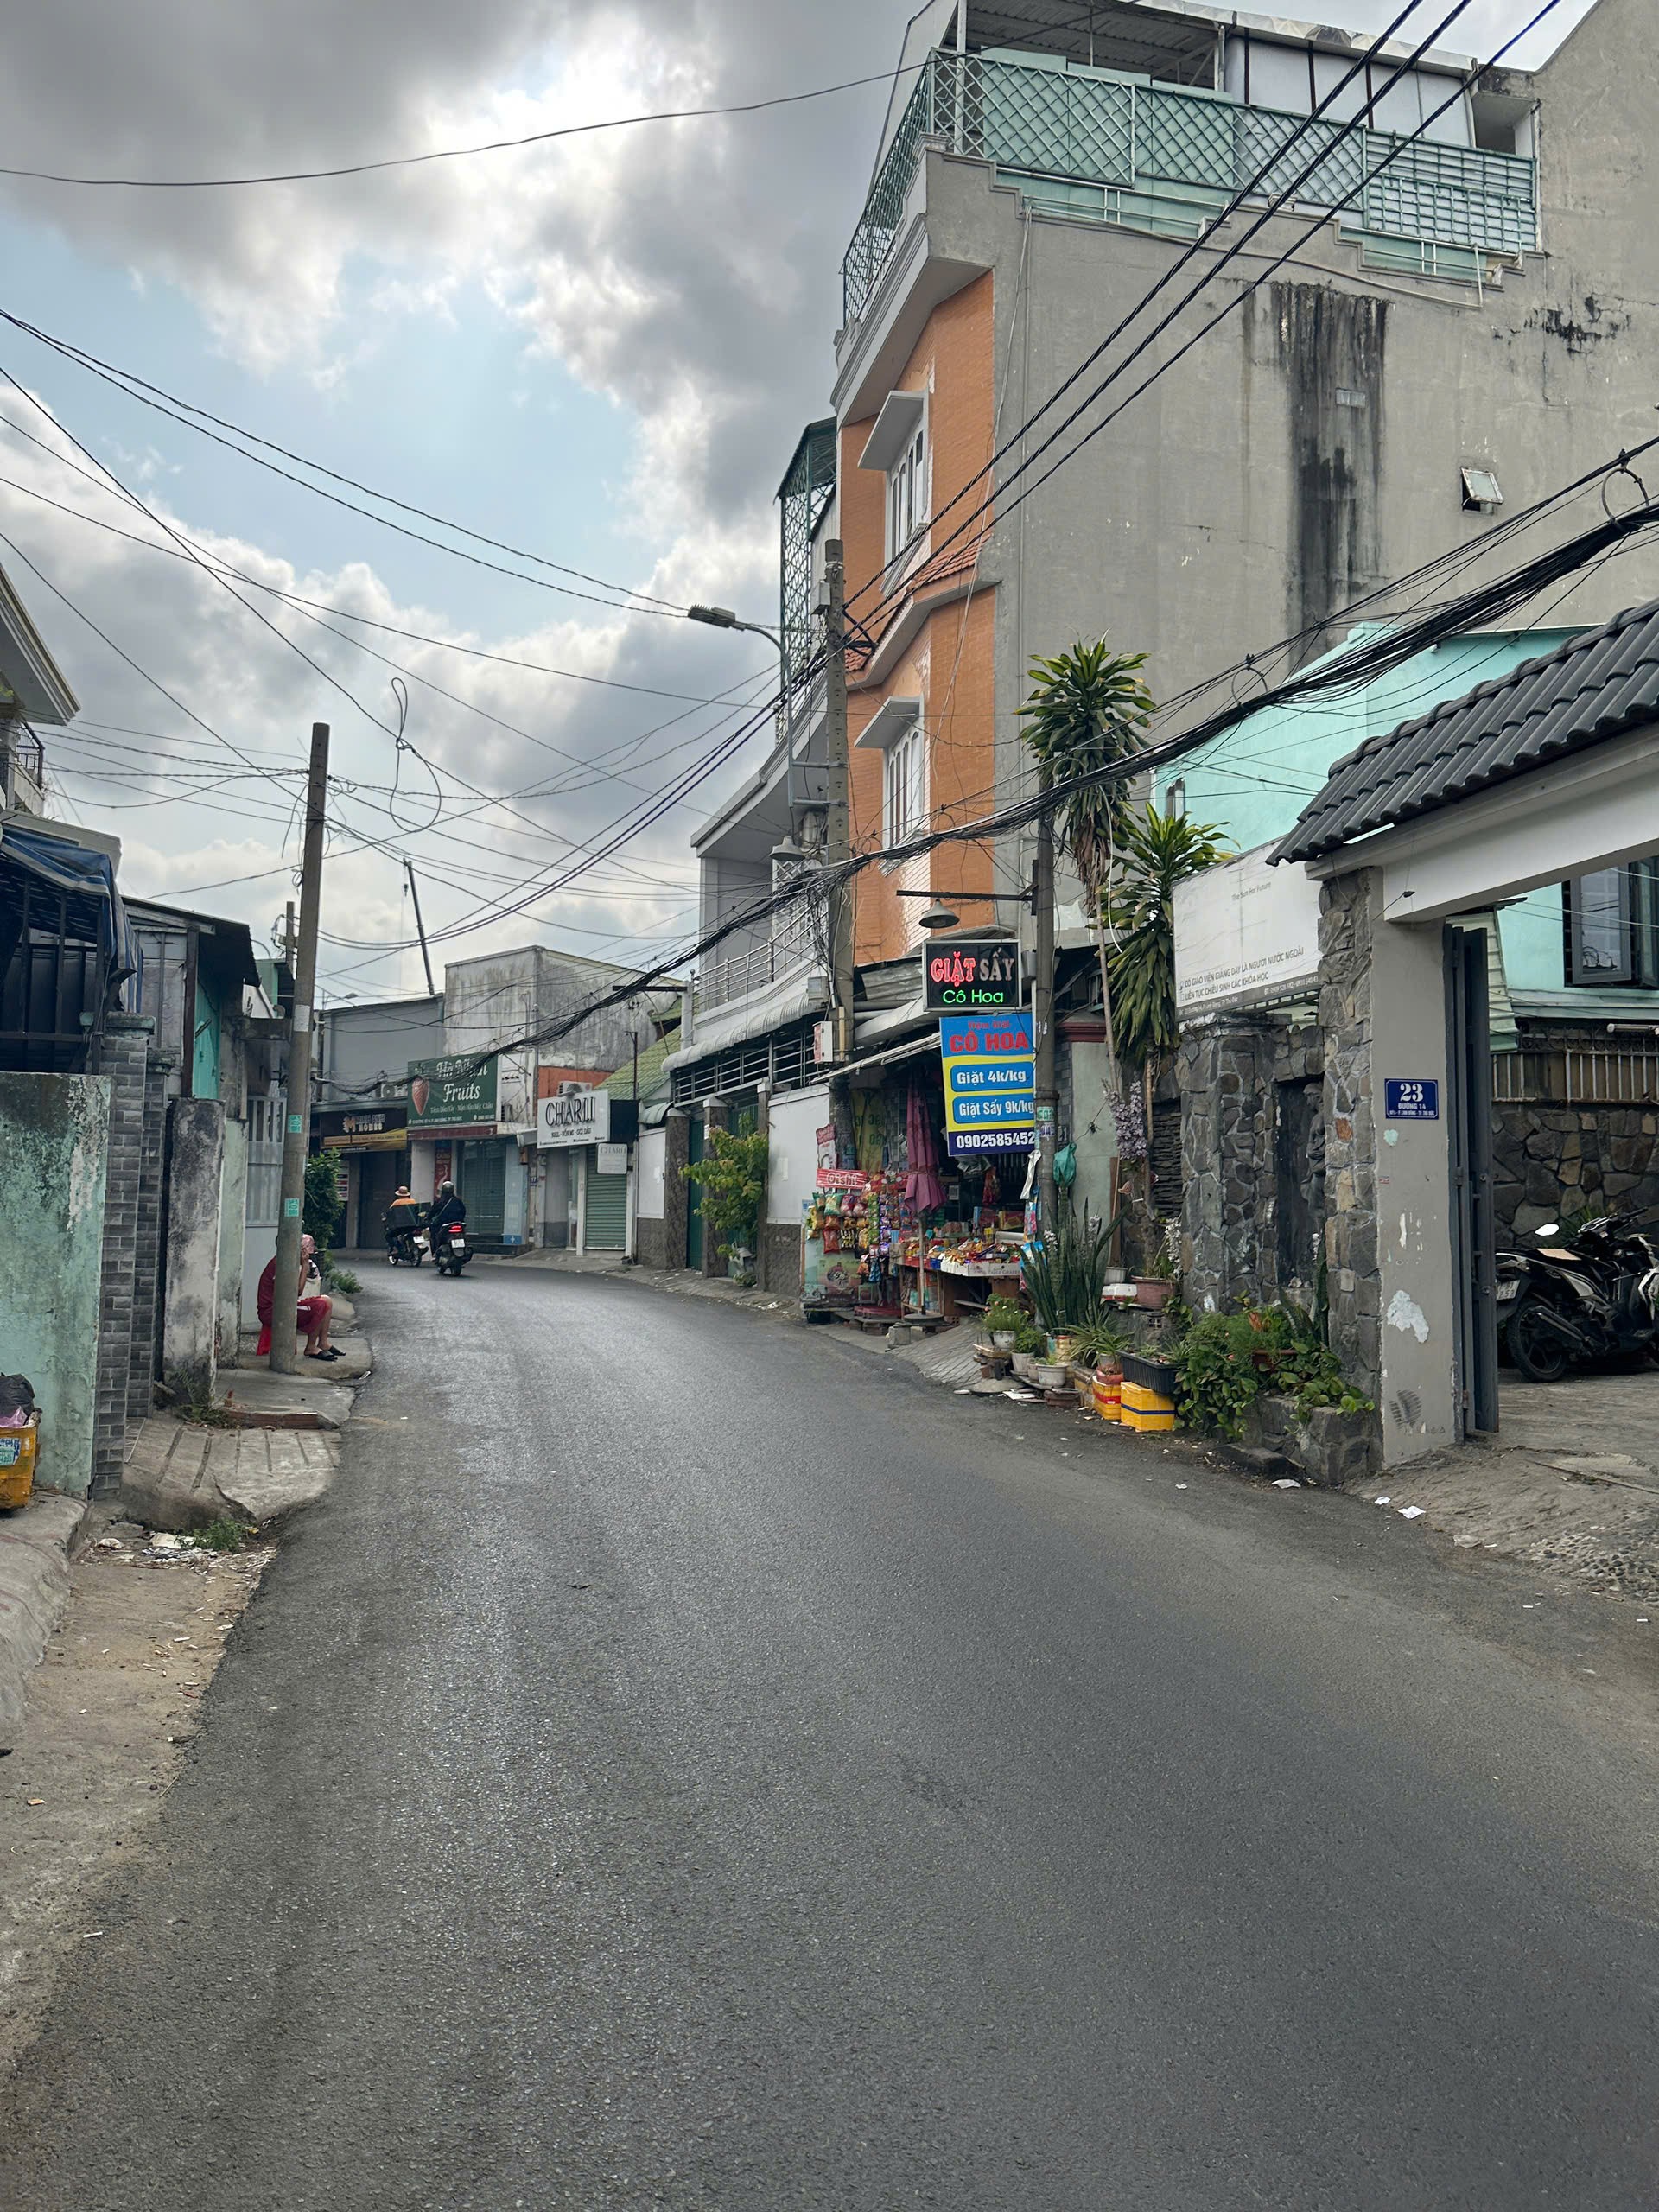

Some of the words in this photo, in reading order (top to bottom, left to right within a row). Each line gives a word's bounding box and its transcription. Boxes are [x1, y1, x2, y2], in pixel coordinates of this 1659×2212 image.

[931, 951, 976, 988] GIẶT
[979, 946, 1014, 982] SẤY
[1241, 961, 1248, 973] LÀ
[1249, 957, 1267, 969] NGƯỜI
[1267, 951, 1285, 964] NƯỚC
[1285, 944, 1304, 959] NGOÀI
[1231, 978, 1242, 988] CÁC
[943, 989, 967, 1003] Cô
[971, 989, 1003, 1003] Hoa
[950, 1030, 978, 1052] CÔ
[985, 1031, 1028, 1051] HOA
[957, 1071, 984, 1086] Giặt
[988, 1070, 1027, 1083] 4k/kg
[442, 1083, 480, 1103] Fruits
[1400, 1083, 1424, 1102] 23
[545, 1096, 595, 1127] CHARLI
[959, 1103, 981, 1118] Giặt
[983, 1099, 1002, 1116] Sấy
[1005, 1100, 1035, 1115] 9k/kg
[956, 1132, 1035, 1149] 0902585452
[827, 1172, 858, 1186] Oishi
